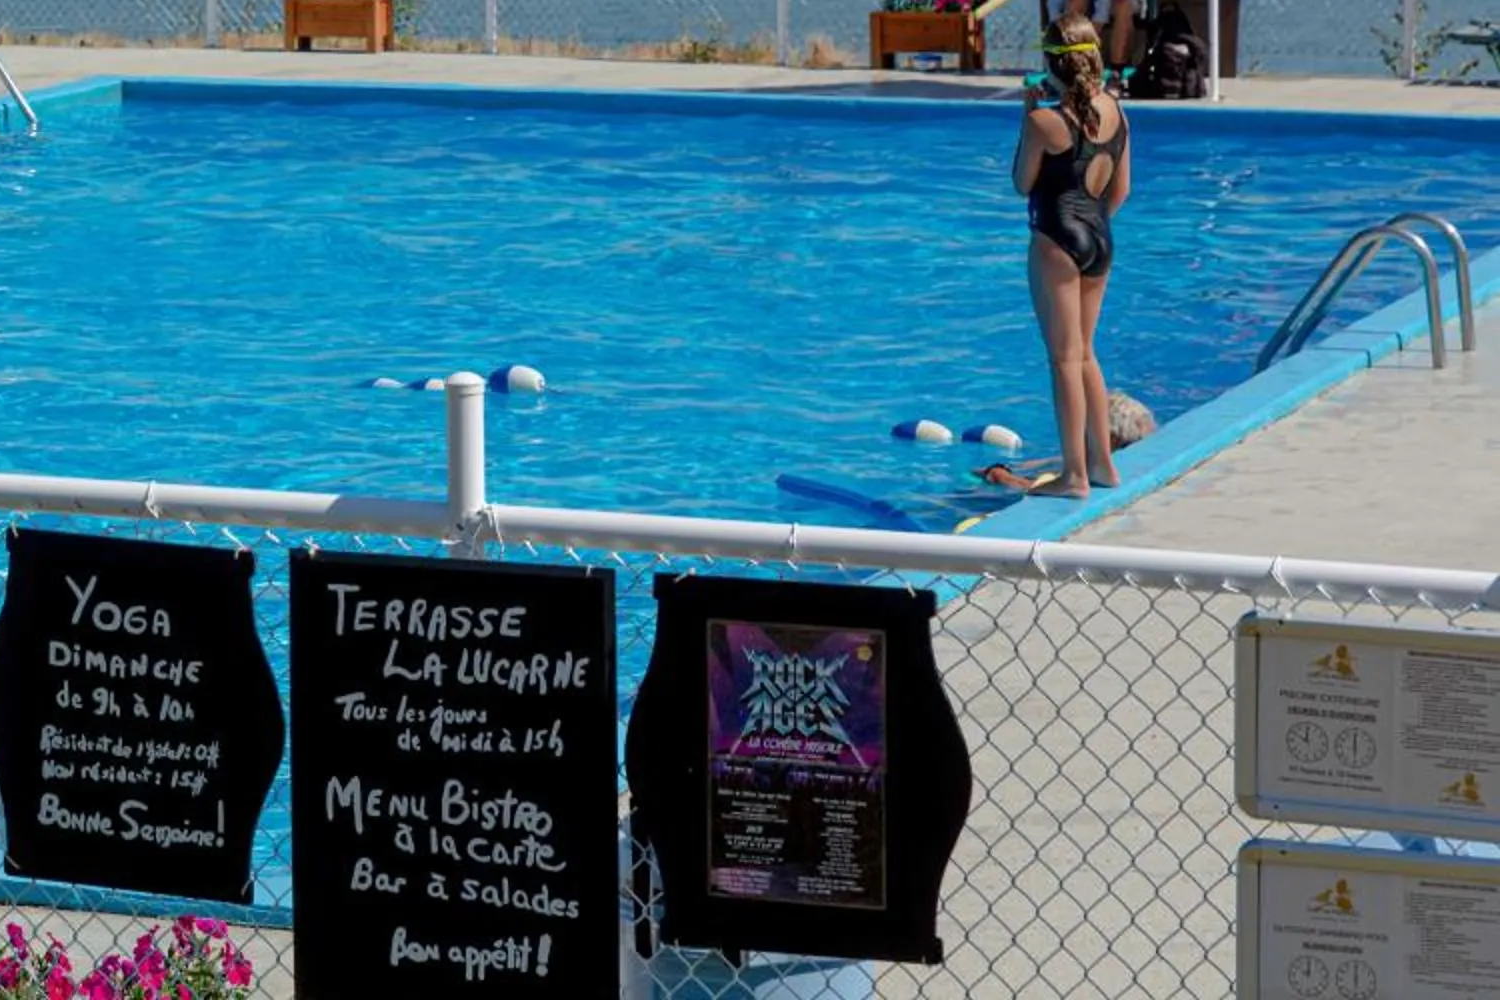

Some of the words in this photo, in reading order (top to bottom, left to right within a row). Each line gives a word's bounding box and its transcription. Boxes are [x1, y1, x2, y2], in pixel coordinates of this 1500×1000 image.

[64, 574, 172, 637] YOGA
[326, 583, 527, 643] TERRASSE
[382, 638, 449, 688] LA
[456, 648, 592, 696] LUCARNE
[740, 646, 850, 706] ROCK
[55, 679, 84, 709] de
[91, 685, 122, 719] 9h
[132, 692, 151, 719] à
[158, 692, 196, 722] 10h
[334, 691, 388, 722] Tous
[395, 694, 426, 724] les
[428, 698, 488, 745] jours
[736, 697, 858, 748] AGES
[396, 728, 422, 752] de
[498, 728, 517, 753] à
[522, 719, 565, 757] 15h
[325, 775, 430, 836] MENU
[393, 822, 416, 855] à
[429, 825, 463, 861] la
[350, 856, 407, 894] Bar
[427, 871, 450, 902] à
[459, 876, 580, 920] salades
